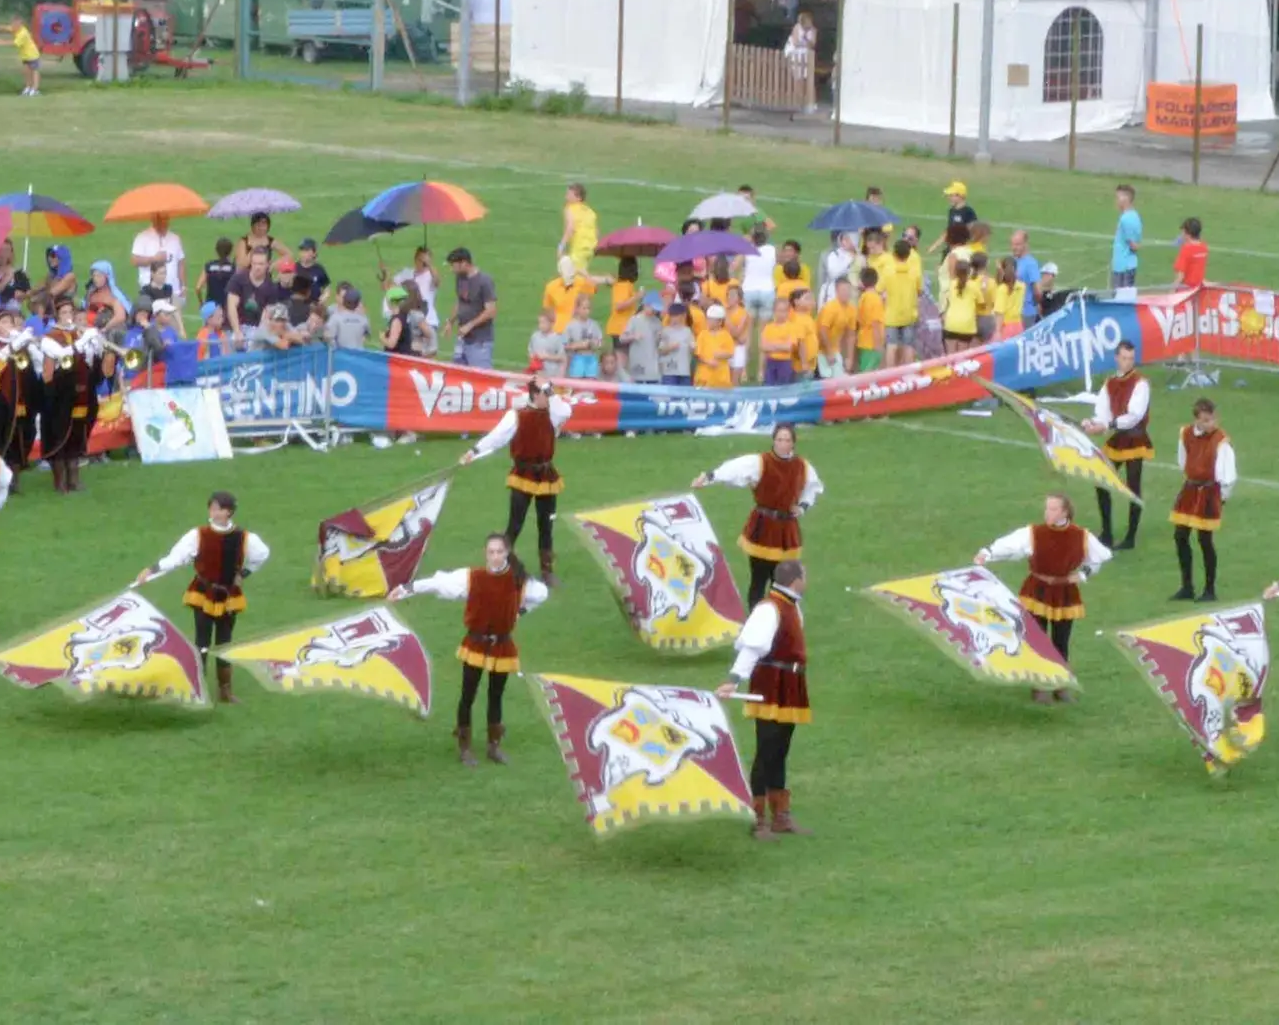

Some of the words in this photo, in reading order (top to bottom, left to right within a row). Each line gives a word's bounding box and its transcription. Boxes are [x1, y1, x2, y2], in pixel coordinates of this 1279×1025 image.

[1149, 301, 1195, 345] Val
[1198, 312, 1219, 335] di
[409, 371, 472, 418] Val
[479, 386, 508, 410] di
